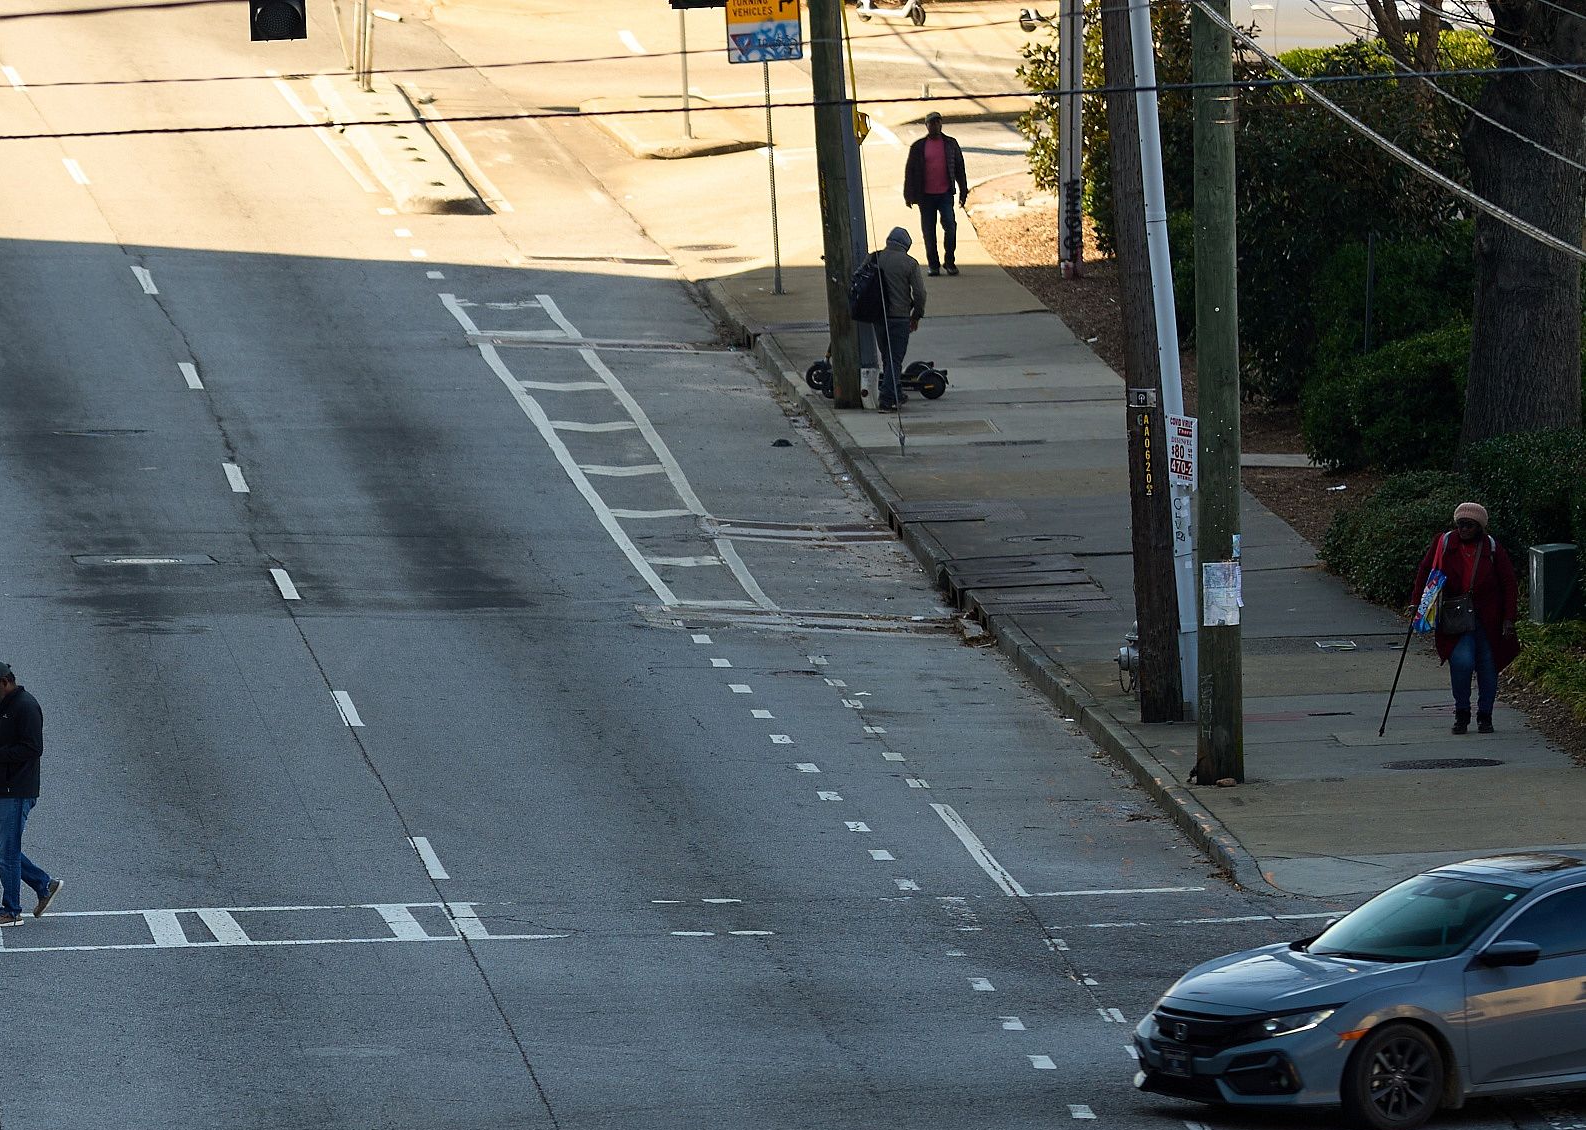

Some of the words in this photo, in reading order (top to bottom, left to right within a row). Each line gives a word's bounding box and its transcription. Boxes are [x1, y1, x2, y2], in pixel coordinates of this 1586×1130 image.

[732, 7, 773, 17] VEHICLES
[1170, 417, 1181, 427] COVID
[1171, 444, 1185, 459] $80
[1171, 460, 1193, 475] 470-2
